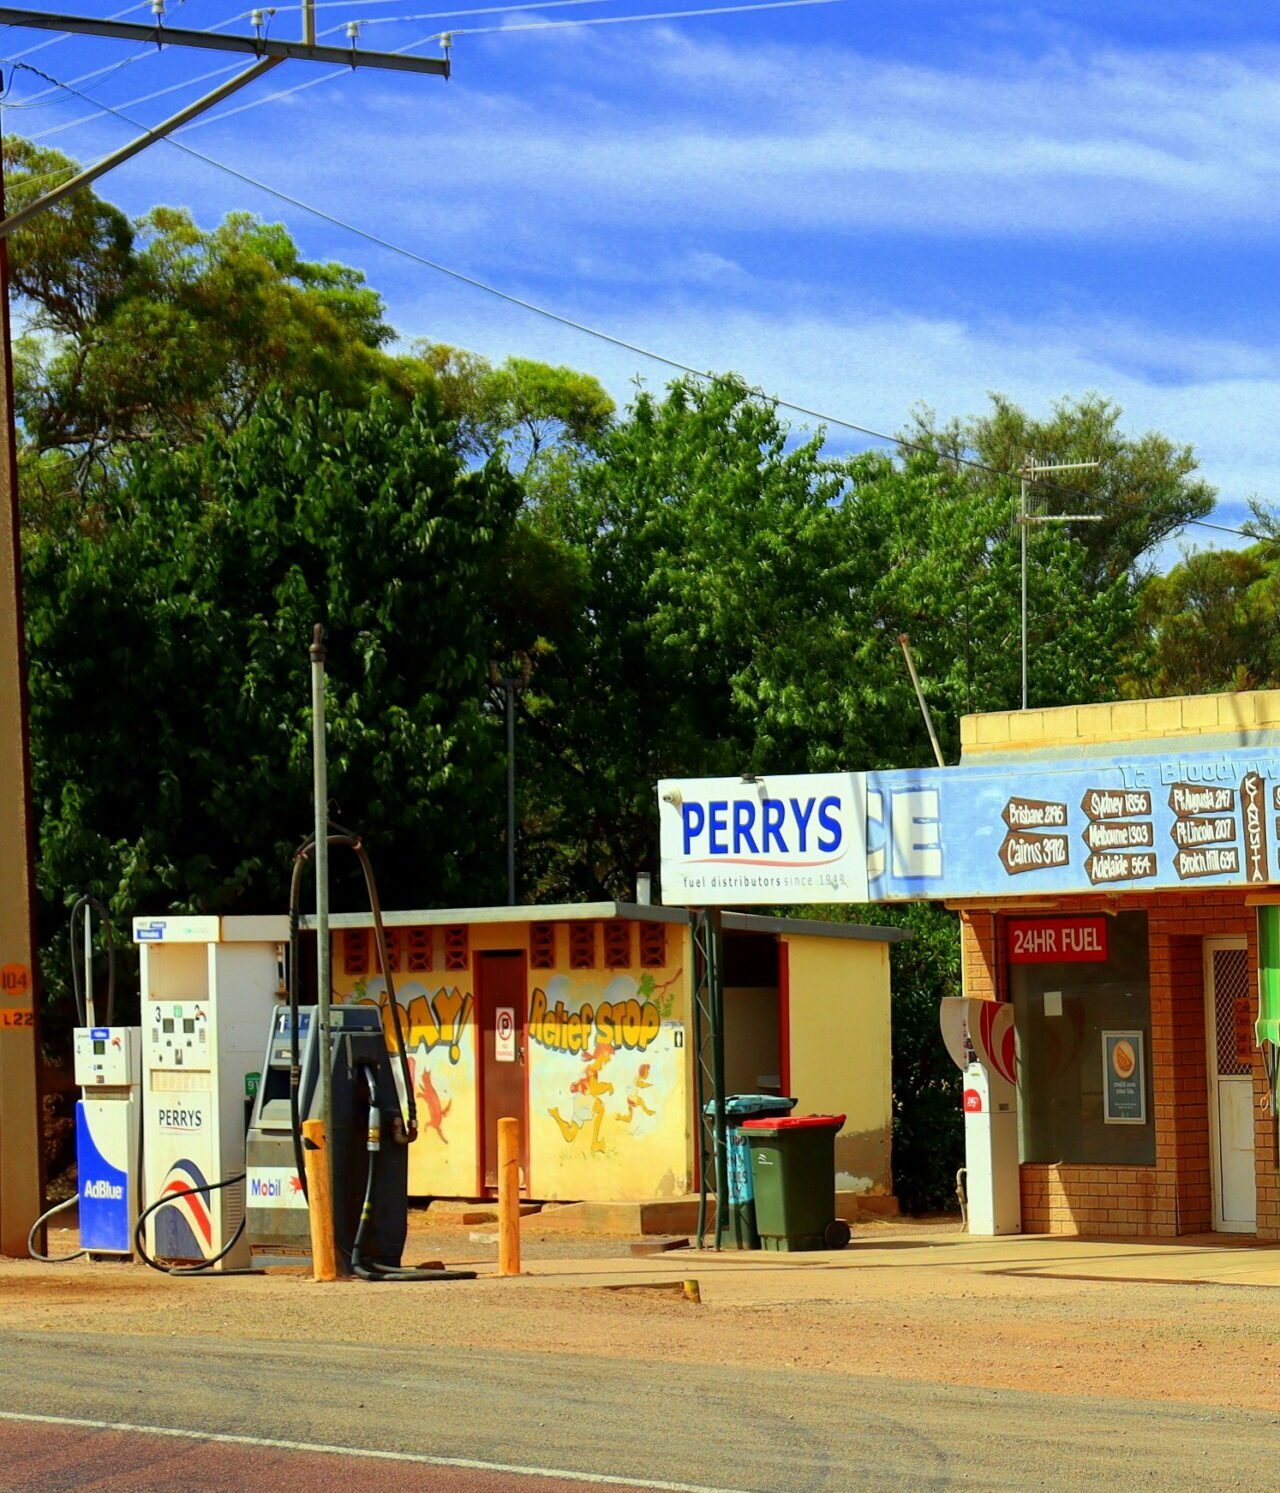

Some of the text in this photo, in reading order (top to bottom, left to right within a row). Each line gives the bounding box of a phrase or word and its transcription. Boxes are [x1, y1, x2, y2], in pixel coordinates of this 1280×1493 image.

[1009, 804, 1044, 825] Brisbane
[1090, 792, 1147, 818] Sydney 1856
[683, 796, 843, 855] PERRYS
[1089, 825, 1148, 847] Melbourne 1303
[1215, 819, 1231, 839] 207
[1245, 777, 1263, 882] KYANCUTTA
[1007, 838, 1065, 866] Cairns 3912
[1091, 854, 1151, 879] Adelaide 564
[684, 877, 705, 888] fuel
[711, 876, 781, 888] distributors
[784, 875, 812, 886] since
[1014, 928, 1102, 953] 24HR FUEL
[3, 1012, 33, 1025] L22
[155, 1006, 161, 1023] 3
[279, 1015, 286, 1034] 1
[528, 987, 660, 1056] Relief STOP
[159, 1109, 202, 1126] PERRYS
[84, 1180, 122, 1199] AdBlue
[251, 1178, 281, 1196] Mobil
